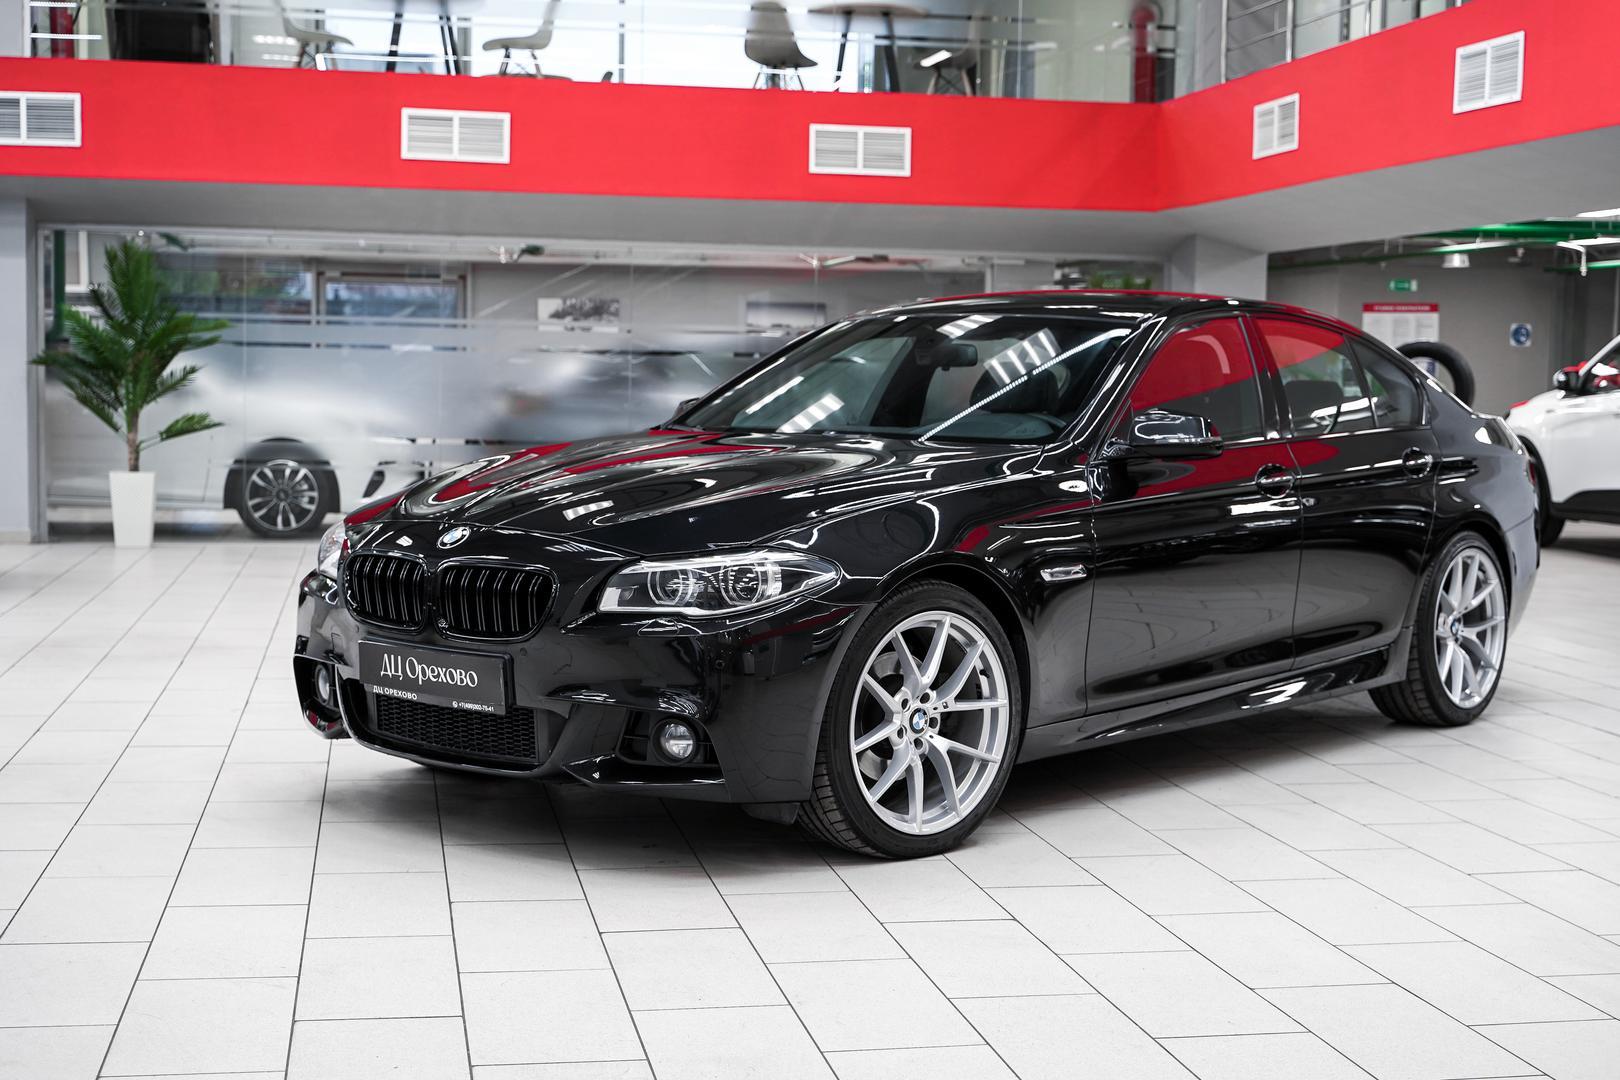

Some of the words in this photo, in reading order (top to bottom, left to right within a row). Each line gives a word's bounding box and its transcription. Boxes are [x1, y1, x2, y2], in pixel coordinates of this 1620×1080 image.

[380, 653, 403, 681] ДЦ
[405, 656, 478, 688] Орехово
[373, 685, 384, 695] ДЦ
[384, 687, 418, 701] ОРЕХОВО
